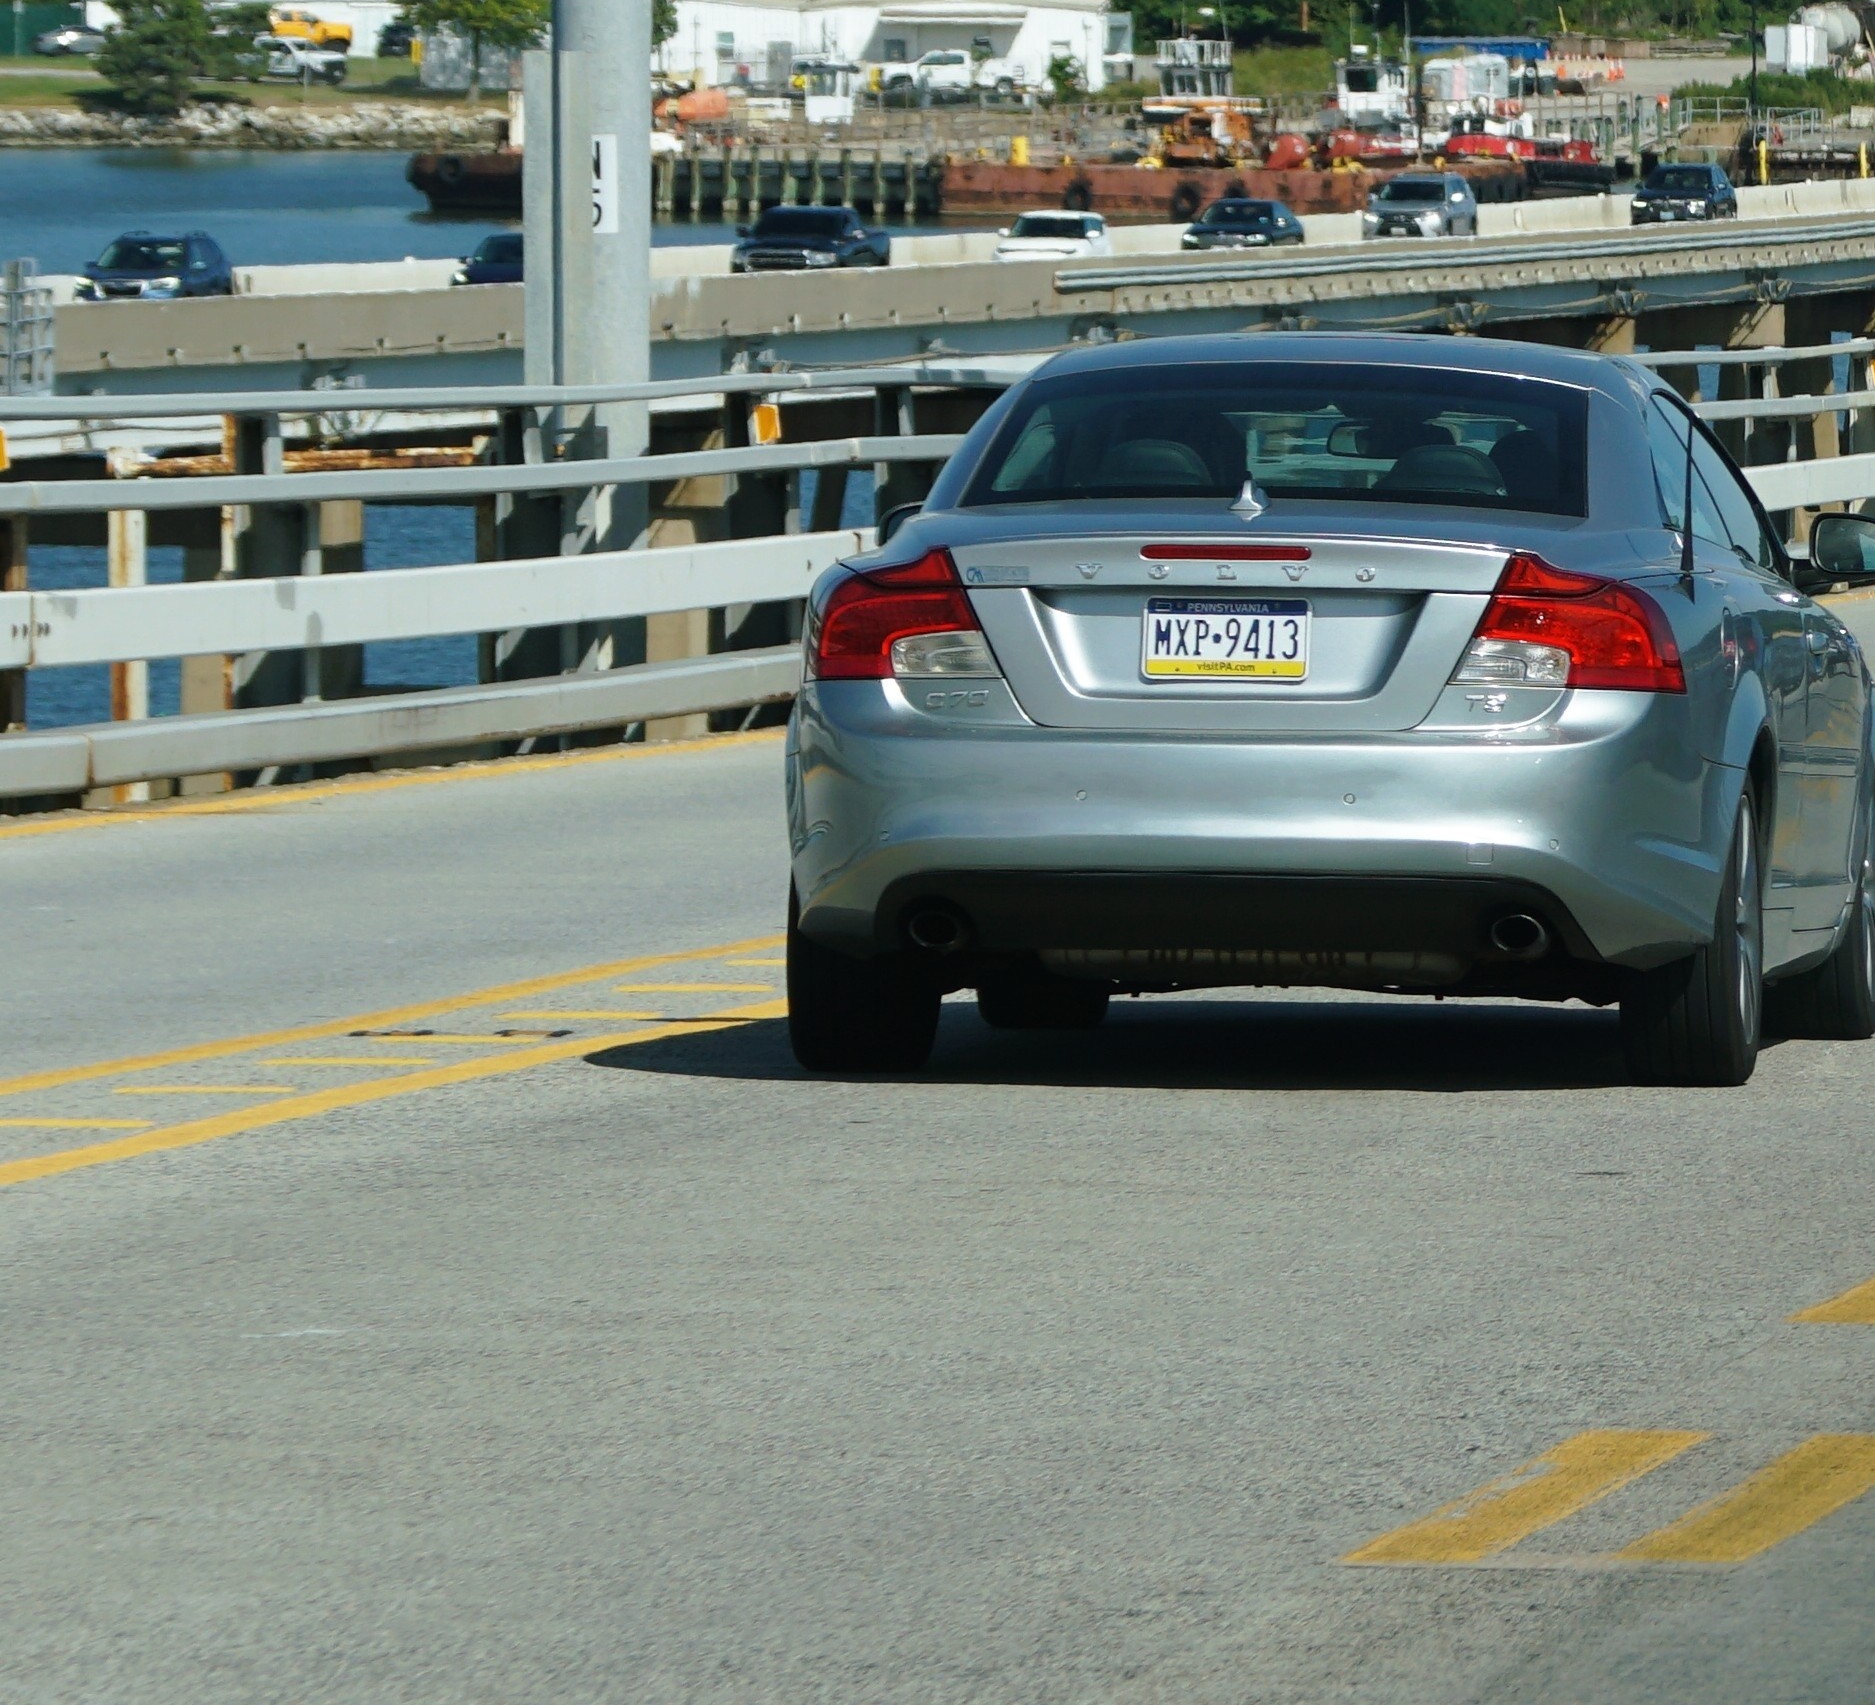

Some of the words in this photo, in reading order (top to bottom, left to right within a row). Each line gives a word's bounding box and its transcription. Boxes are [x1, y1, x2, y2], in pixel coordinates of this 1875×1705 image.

[1076, 562, 1376, 582] VOLVO
[1187, 602, 1269, 613] PENNSYLVANIA
[1196, 661, 1256, 673] visitPA.com
